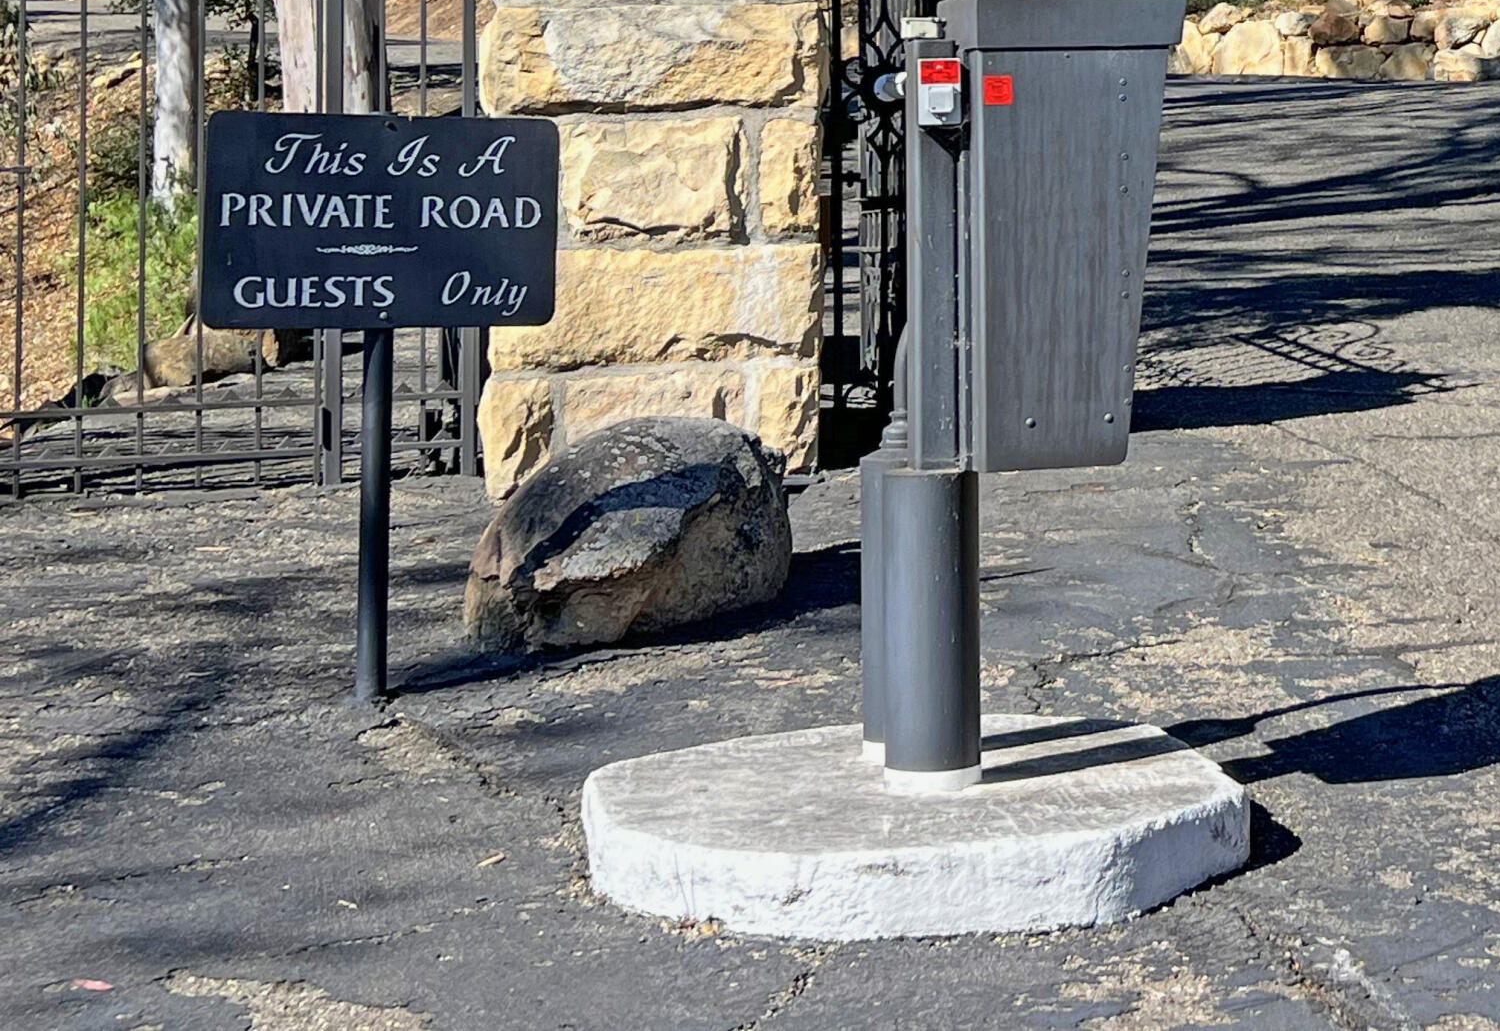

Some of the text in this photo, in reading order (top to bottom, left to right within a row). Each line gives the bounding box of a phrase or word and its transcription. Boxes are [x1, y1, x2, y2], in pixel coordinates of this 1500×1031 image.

[264, 133, 515, 177] This Is A
[219, 193, 541, 229] PRIVATE ROAD
[233, 271, 528, 316] GUESTS Only
